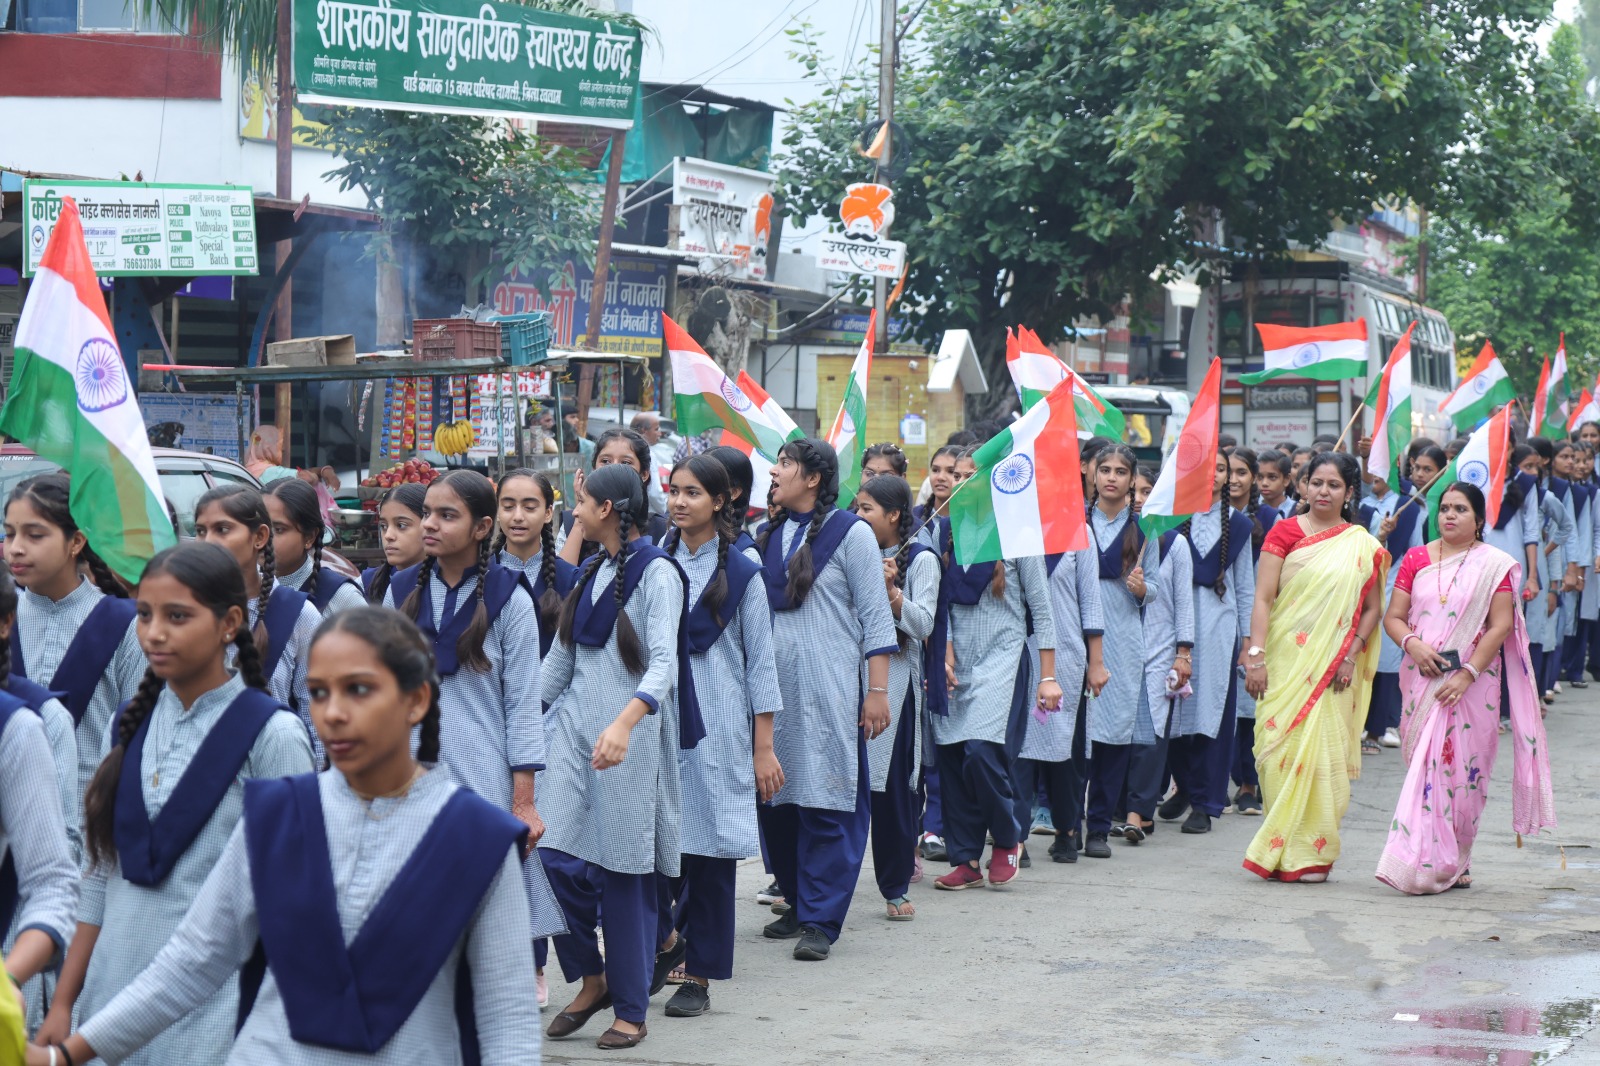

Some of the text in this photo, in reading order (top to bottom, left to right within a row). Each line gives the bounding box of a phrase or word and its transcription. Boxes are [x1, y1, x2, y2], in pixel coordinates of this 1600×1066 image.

[317, 0, 636, 80] शासकीय सामुदायिक स्वास्थ्य केन्द्र
[403, 70, 418, 92] वार्ड
[444, 79, 455, 96] 15
[455, 80, 473, 97] नगर
[100, 201, 131, 220] क्लासेस
[133, 198, 161, 220] नामली
[195, 221, 228, 236] Vidhyalaya
[170, 245, 183, 254] ARMY
[199, 238, 224, 255] Special
[123, 258, 162, 269] 7566337384
[209, 252, 229, 265] Batch
[620, 274, 667, 308] नामली
[620, 308, 649, 332] मिलती
[650, 310, 658, 335] है
